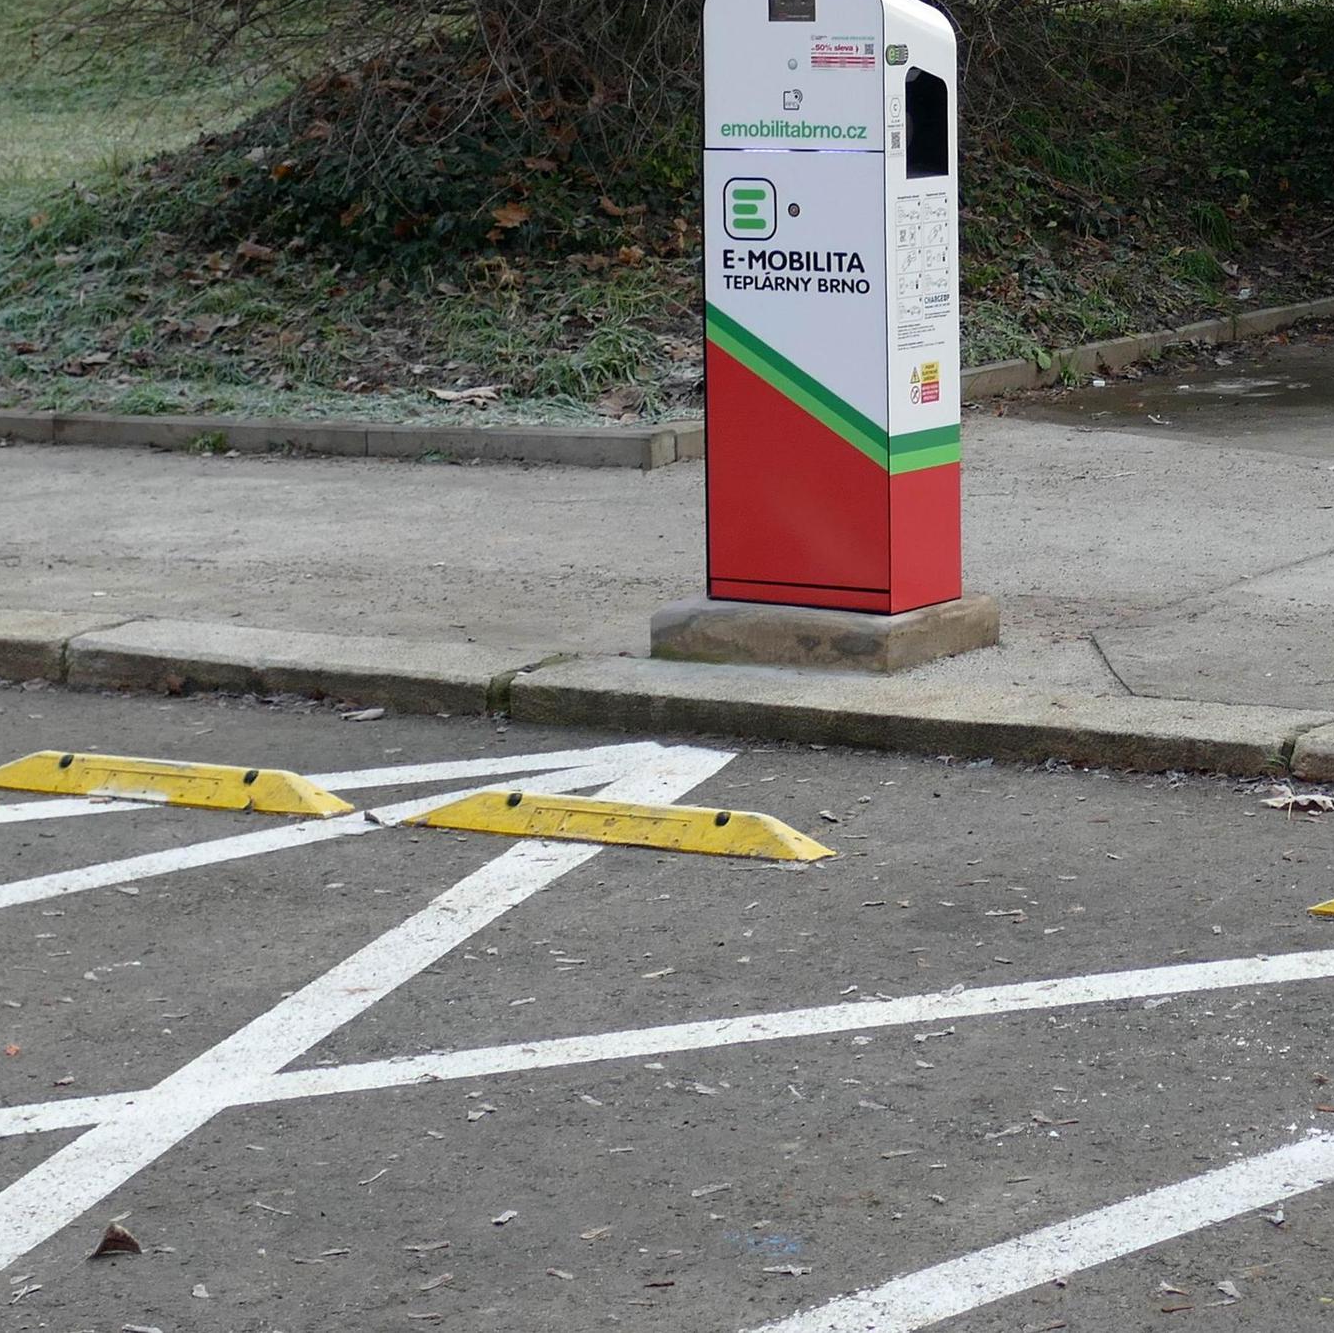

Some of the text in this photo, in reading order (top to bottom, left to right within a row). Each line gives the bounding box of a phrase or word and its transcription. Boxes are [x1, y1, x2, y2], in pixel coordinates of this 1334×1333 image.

[720, 120, 867, 139] emobilitabrno.cz
[723, 249, 865, 273] E-MOBILITA
[723, 272, 871, 294] TEPLÁRNY BRNO
